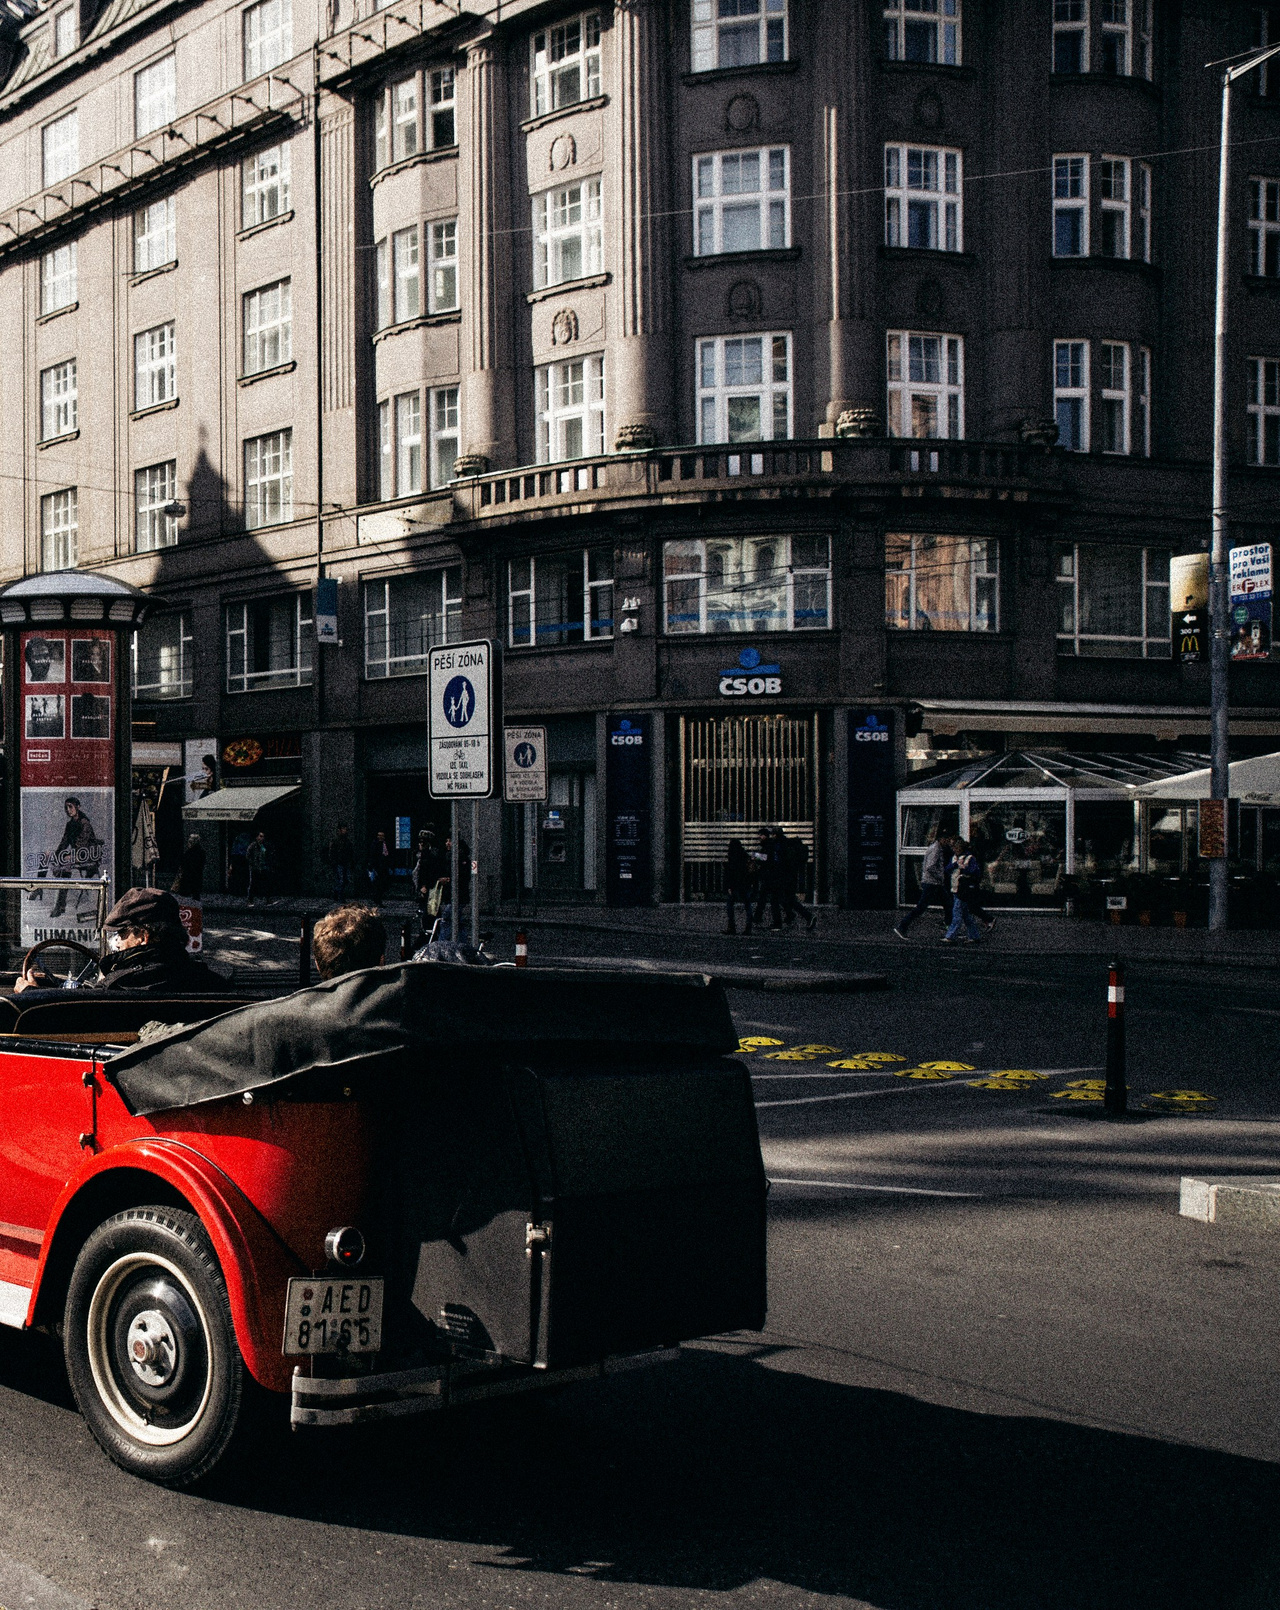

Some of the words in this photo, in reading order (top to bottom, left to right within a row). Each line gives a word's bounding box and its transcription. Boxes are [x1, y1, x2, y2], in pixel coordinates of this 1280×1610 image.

[1232, 545, 1270, 561] prostor
[1232, 561, 1249, 571] pro
[1232, 567, 1270, 579] reklamu
[434, 652, 455, 670] PĚŠÍ
[458, 651, 484, 668] ZÓNA
[718, 676, 783, 696] ČSOB
[610, 734, 644, 747] ČSOB
[854, 730, 890, 743] ČSOB
[321, 1284, 370, 1314] AED
